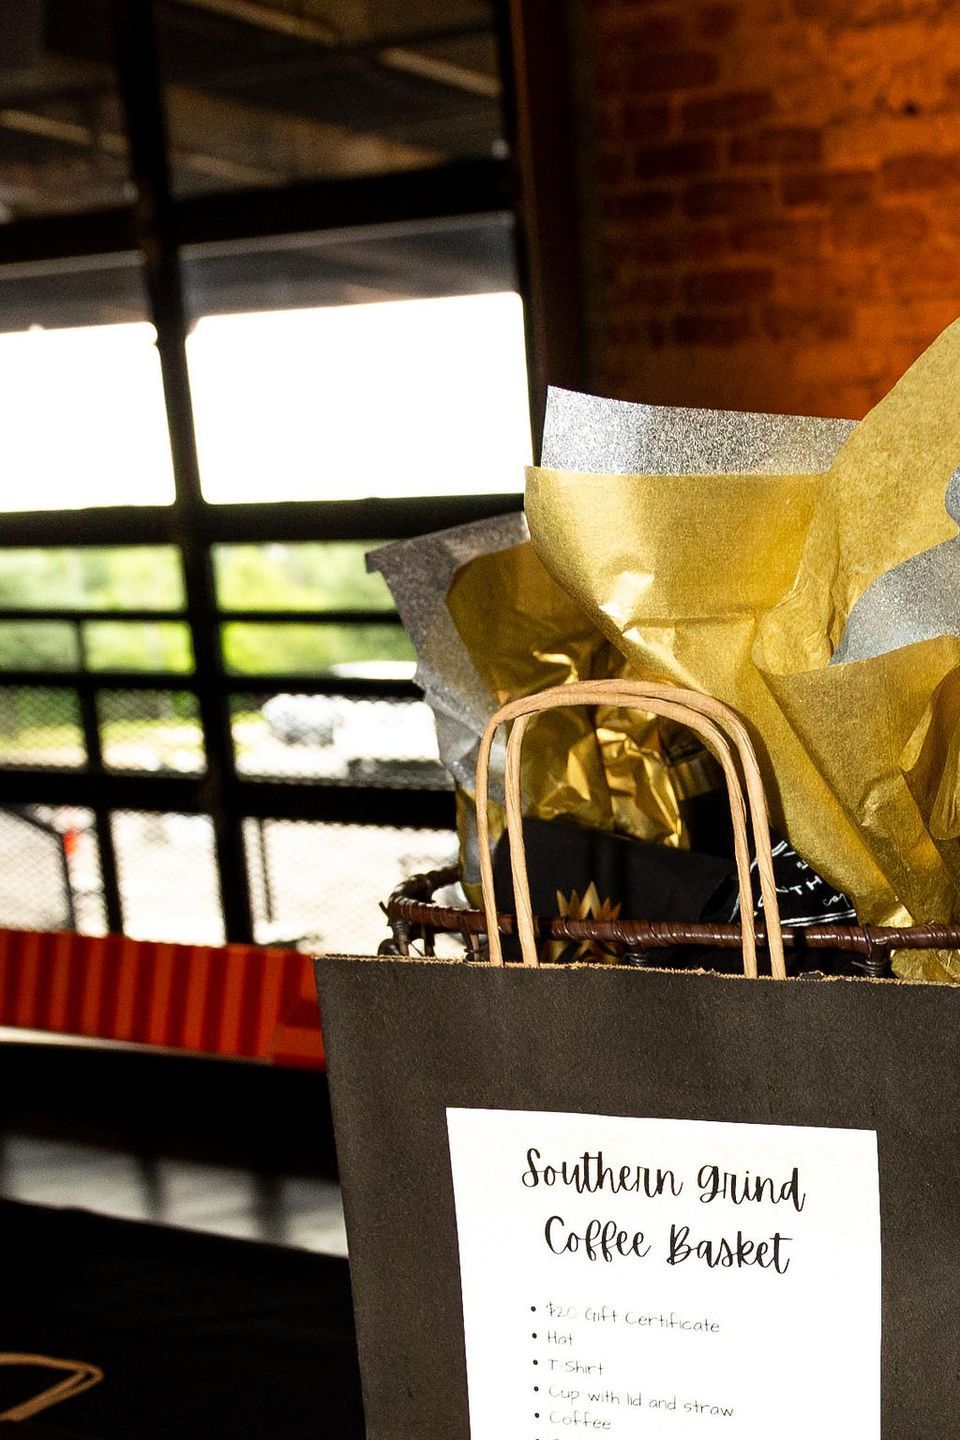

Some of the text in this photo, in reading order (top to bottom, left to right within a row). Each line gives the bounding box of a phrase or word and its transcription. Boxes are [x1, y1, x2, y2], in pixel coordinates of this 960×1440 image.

[521, 1147, 684, 1199] Southern
[544, 1215, 794, 1274] Coffee Basket
[585, 1305, 618, 1323] Gift
[625, 1311, 720, 1333] Certificate
[547, 1330, 573, 1346] Hat
[548, 1384, 735, 1417] Cup with lid and straw
[549, 1410, 612, 1430] Coffee
